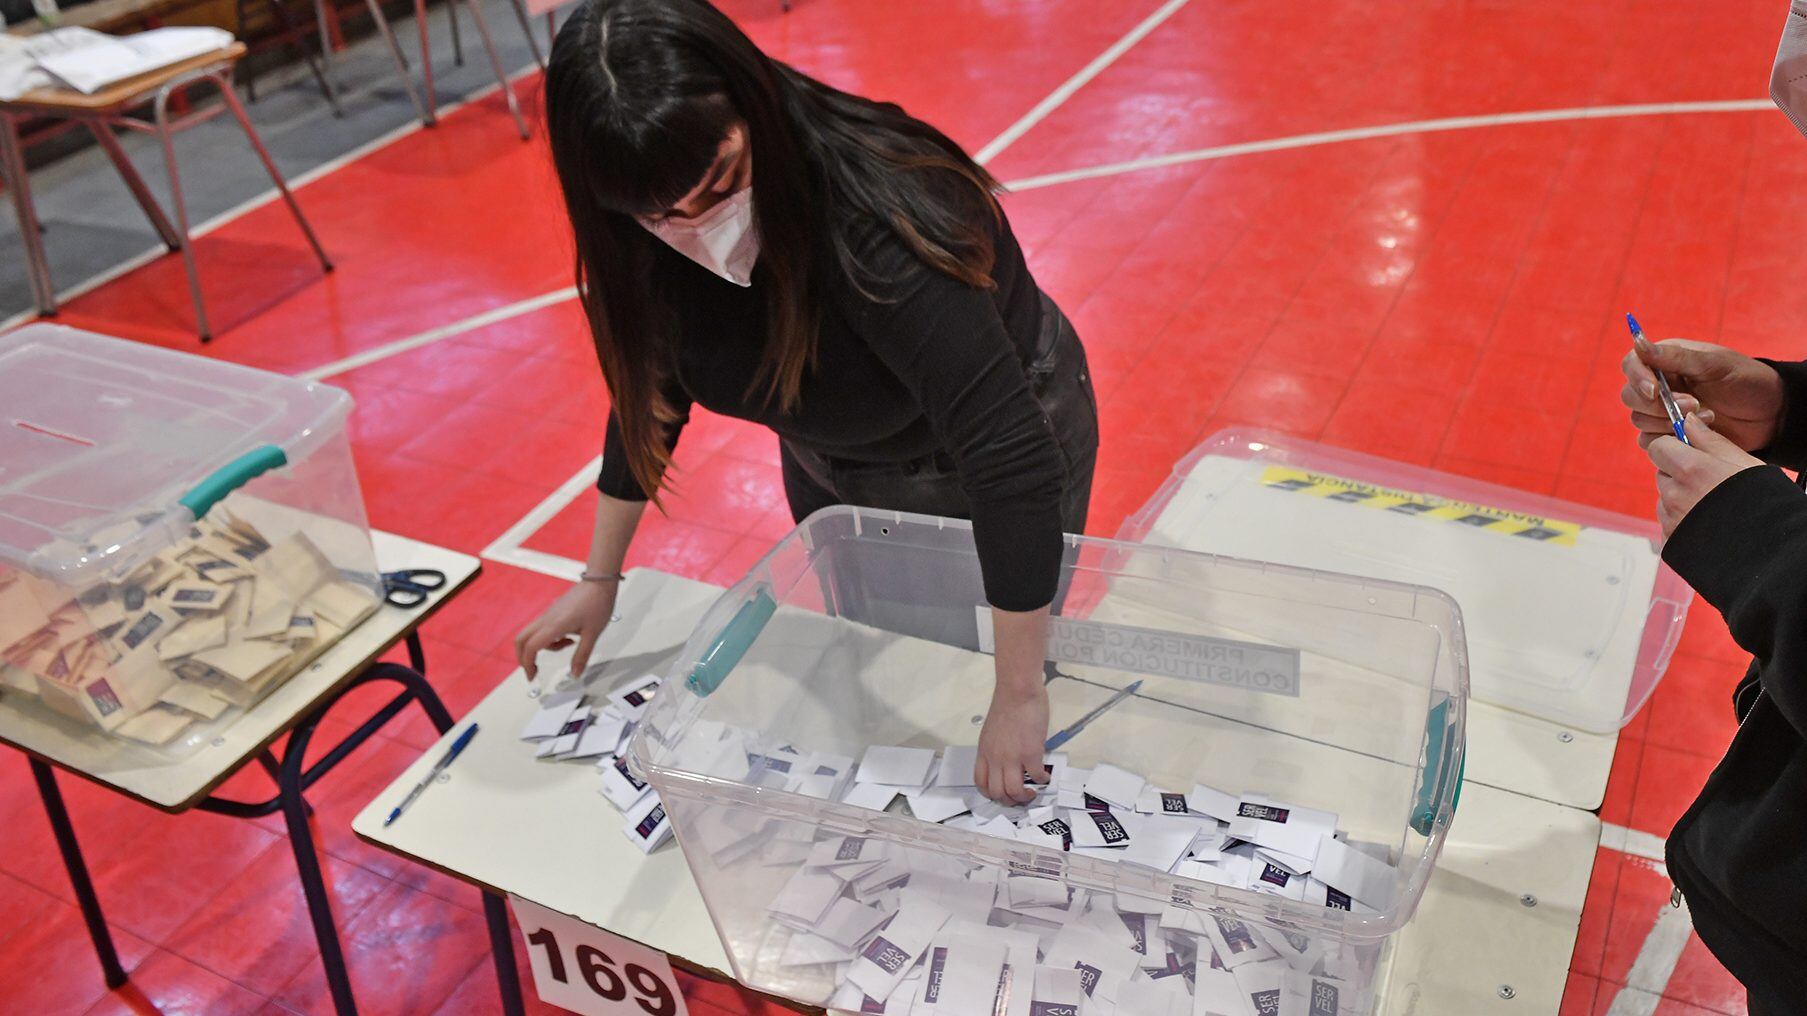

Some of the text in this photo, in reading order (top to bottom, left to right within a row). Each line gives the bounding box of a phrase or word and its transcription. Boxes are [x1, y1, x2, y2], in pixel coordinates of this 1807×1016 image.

[1099, 821, 1120, 832] VEL
[1103, 829, 1125, 840] SER
[877, 947, 897, 962] VEL
[884, 952, 905, 970] SER
[528, 927, 676, 1016] 169
[1316, 985, 1334, 1000] SER
[1258, 994, 1275, 1014] SER
[1315, 996, 1333, 1013] VEL
